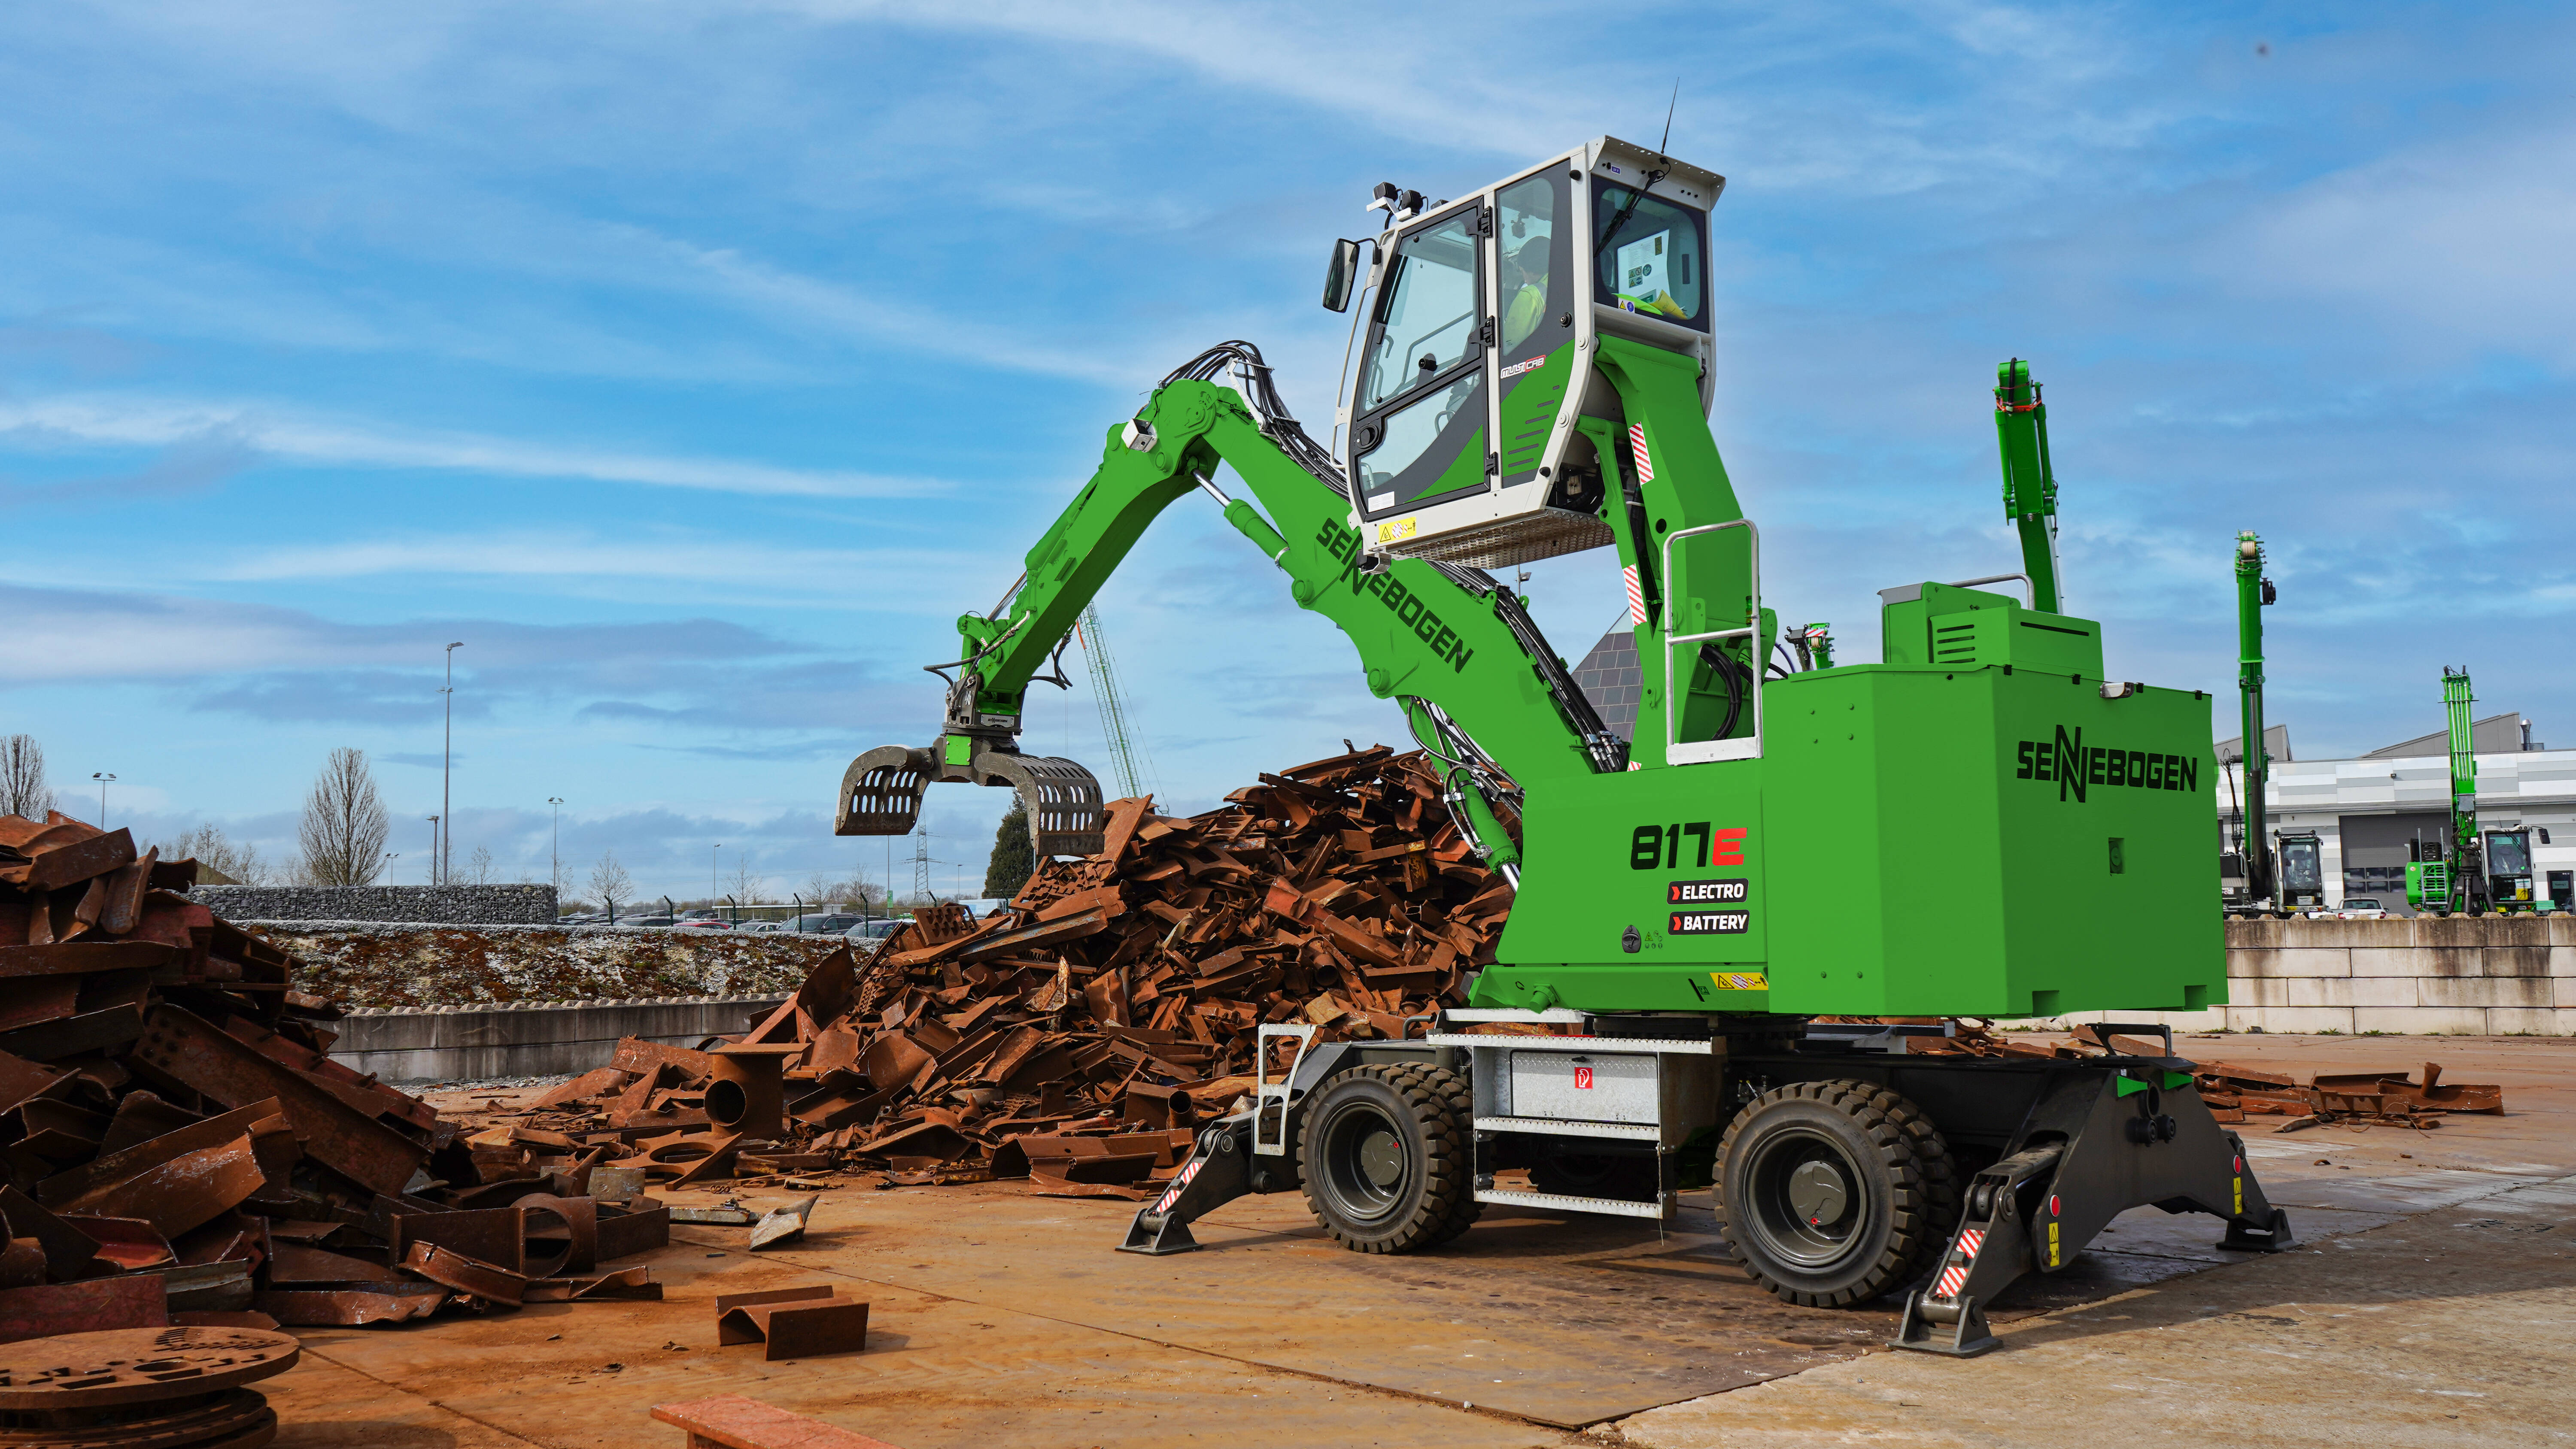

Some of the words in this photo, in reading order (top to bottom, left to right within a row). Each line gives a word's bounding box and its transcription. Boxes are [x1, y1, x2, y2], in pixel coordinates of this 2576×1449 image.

[2017, 724, 2196, 803] SENNEBOGEN
[1631, 822, 1747, 870] 817E
[1682, 883, 1744, 900] ELECTRO
[1683, 914, 1747, 931] BATTERY
